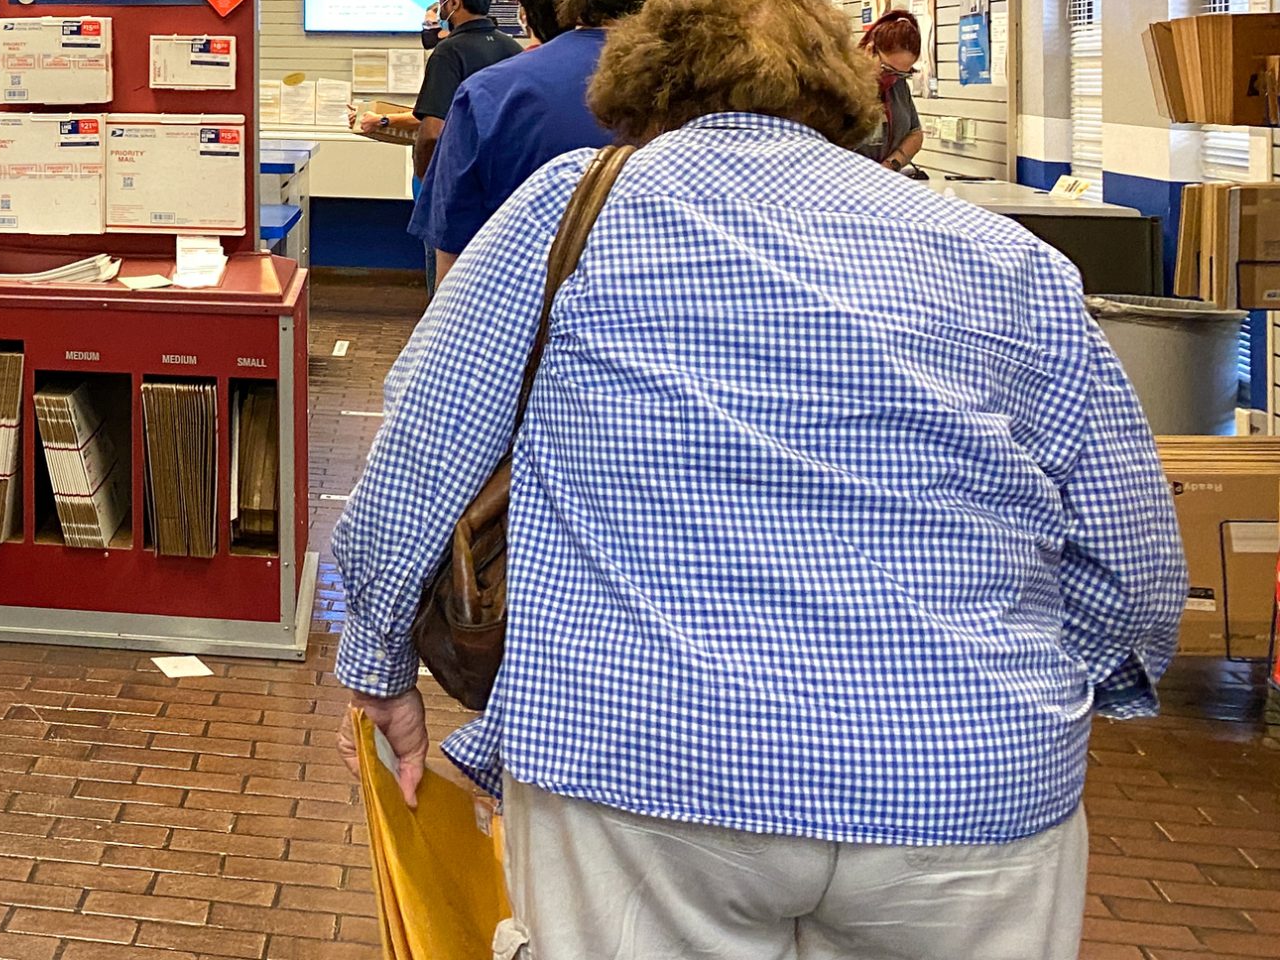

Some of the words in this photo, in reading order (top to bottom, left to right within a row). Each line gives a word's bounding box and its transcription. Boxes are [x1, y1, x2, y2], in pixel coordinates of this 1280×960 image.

[66, 351, 100, 361] MEDIUM
[162, 354, 197, 365] MEDIUM
[237, 357, 267, 368] SMALL
